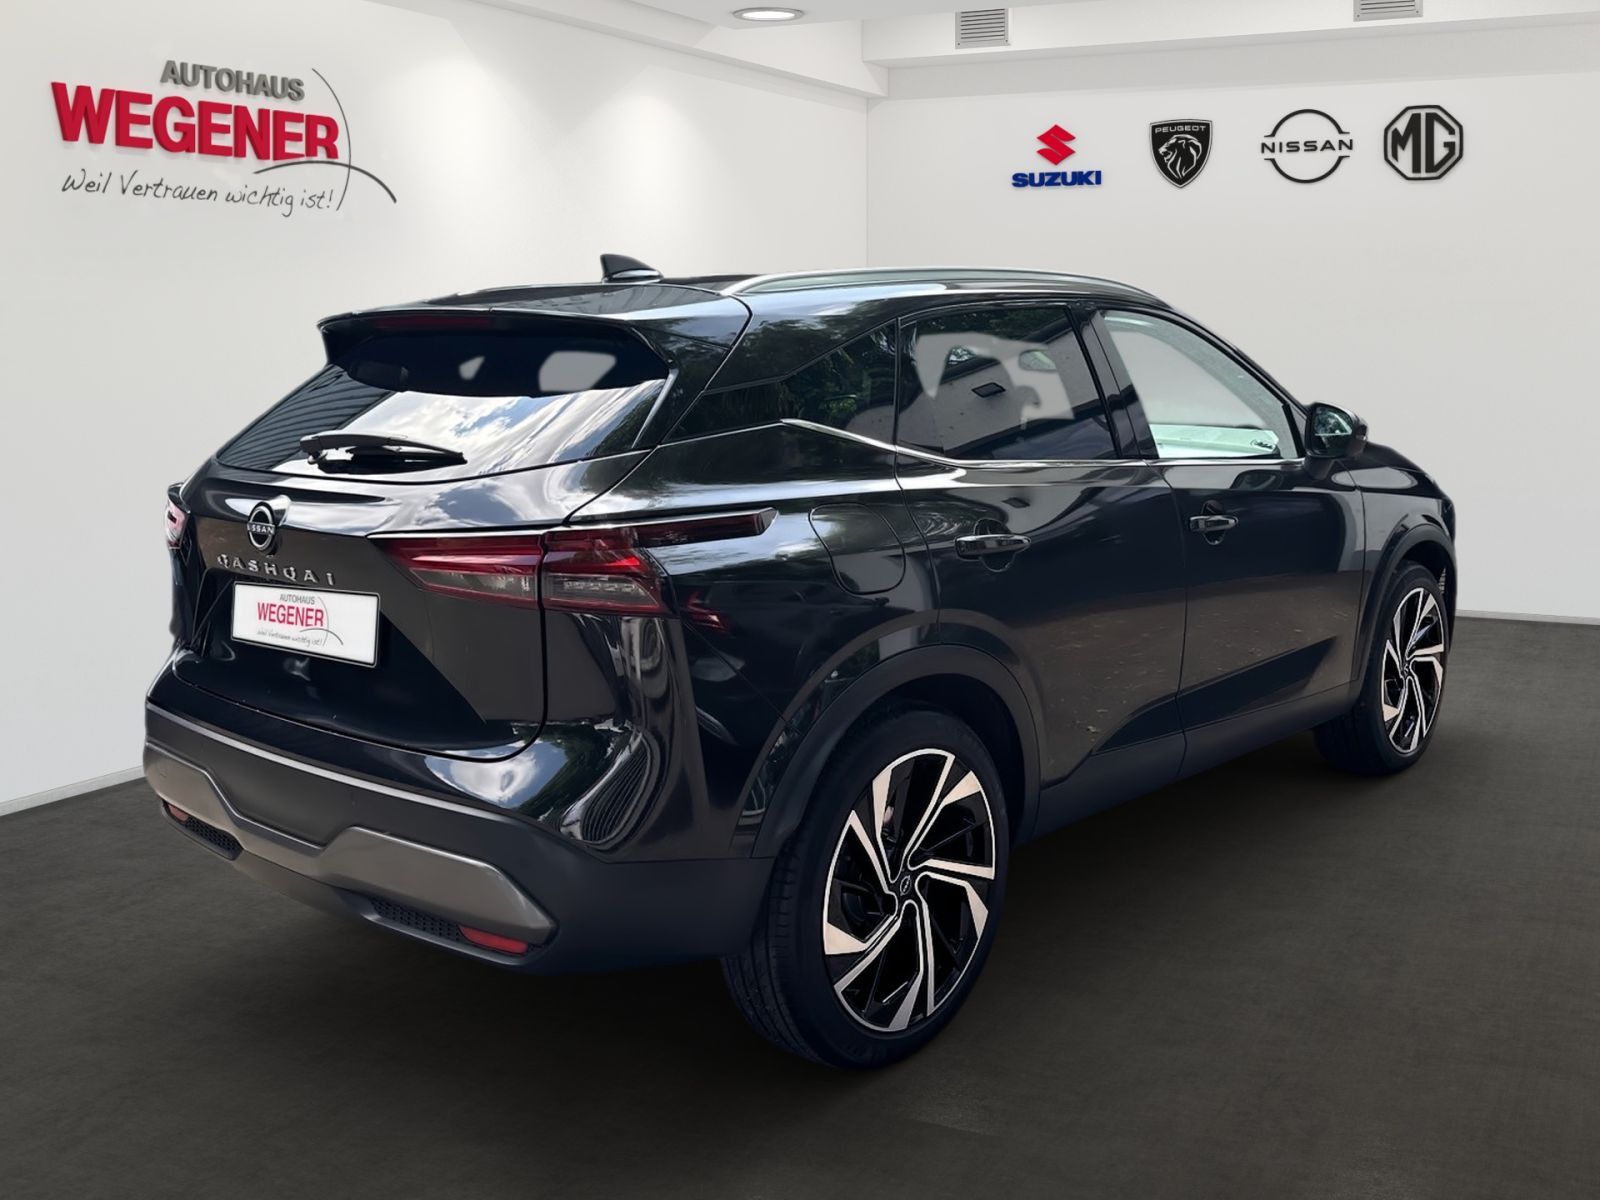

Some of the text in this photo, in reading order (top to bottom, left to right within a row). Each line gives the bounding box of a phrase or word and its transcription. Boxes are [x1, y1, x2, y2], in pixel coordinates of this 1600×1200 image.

[160, 60, 305, 101] AUTOHAUS
[50, 81, 340, 161] WEGENER
[1154, 125, 1207, 134] PEUGEOT
[1261, 139, 1353, 154] NISSAN
[1391, 112, 1456, 174] MG
[1011, 170, 1102, 188] SUZUKI
[61, 168, 334, 218] Weil Vertrauen wichtig ist!
[246, 522, 275, 535] ISSAN
[217, 553, 335, 586] QASHQAI
[279, 593, 316, 605] AUTOHAUS
[257, 602, 324, 627] WEGENER
